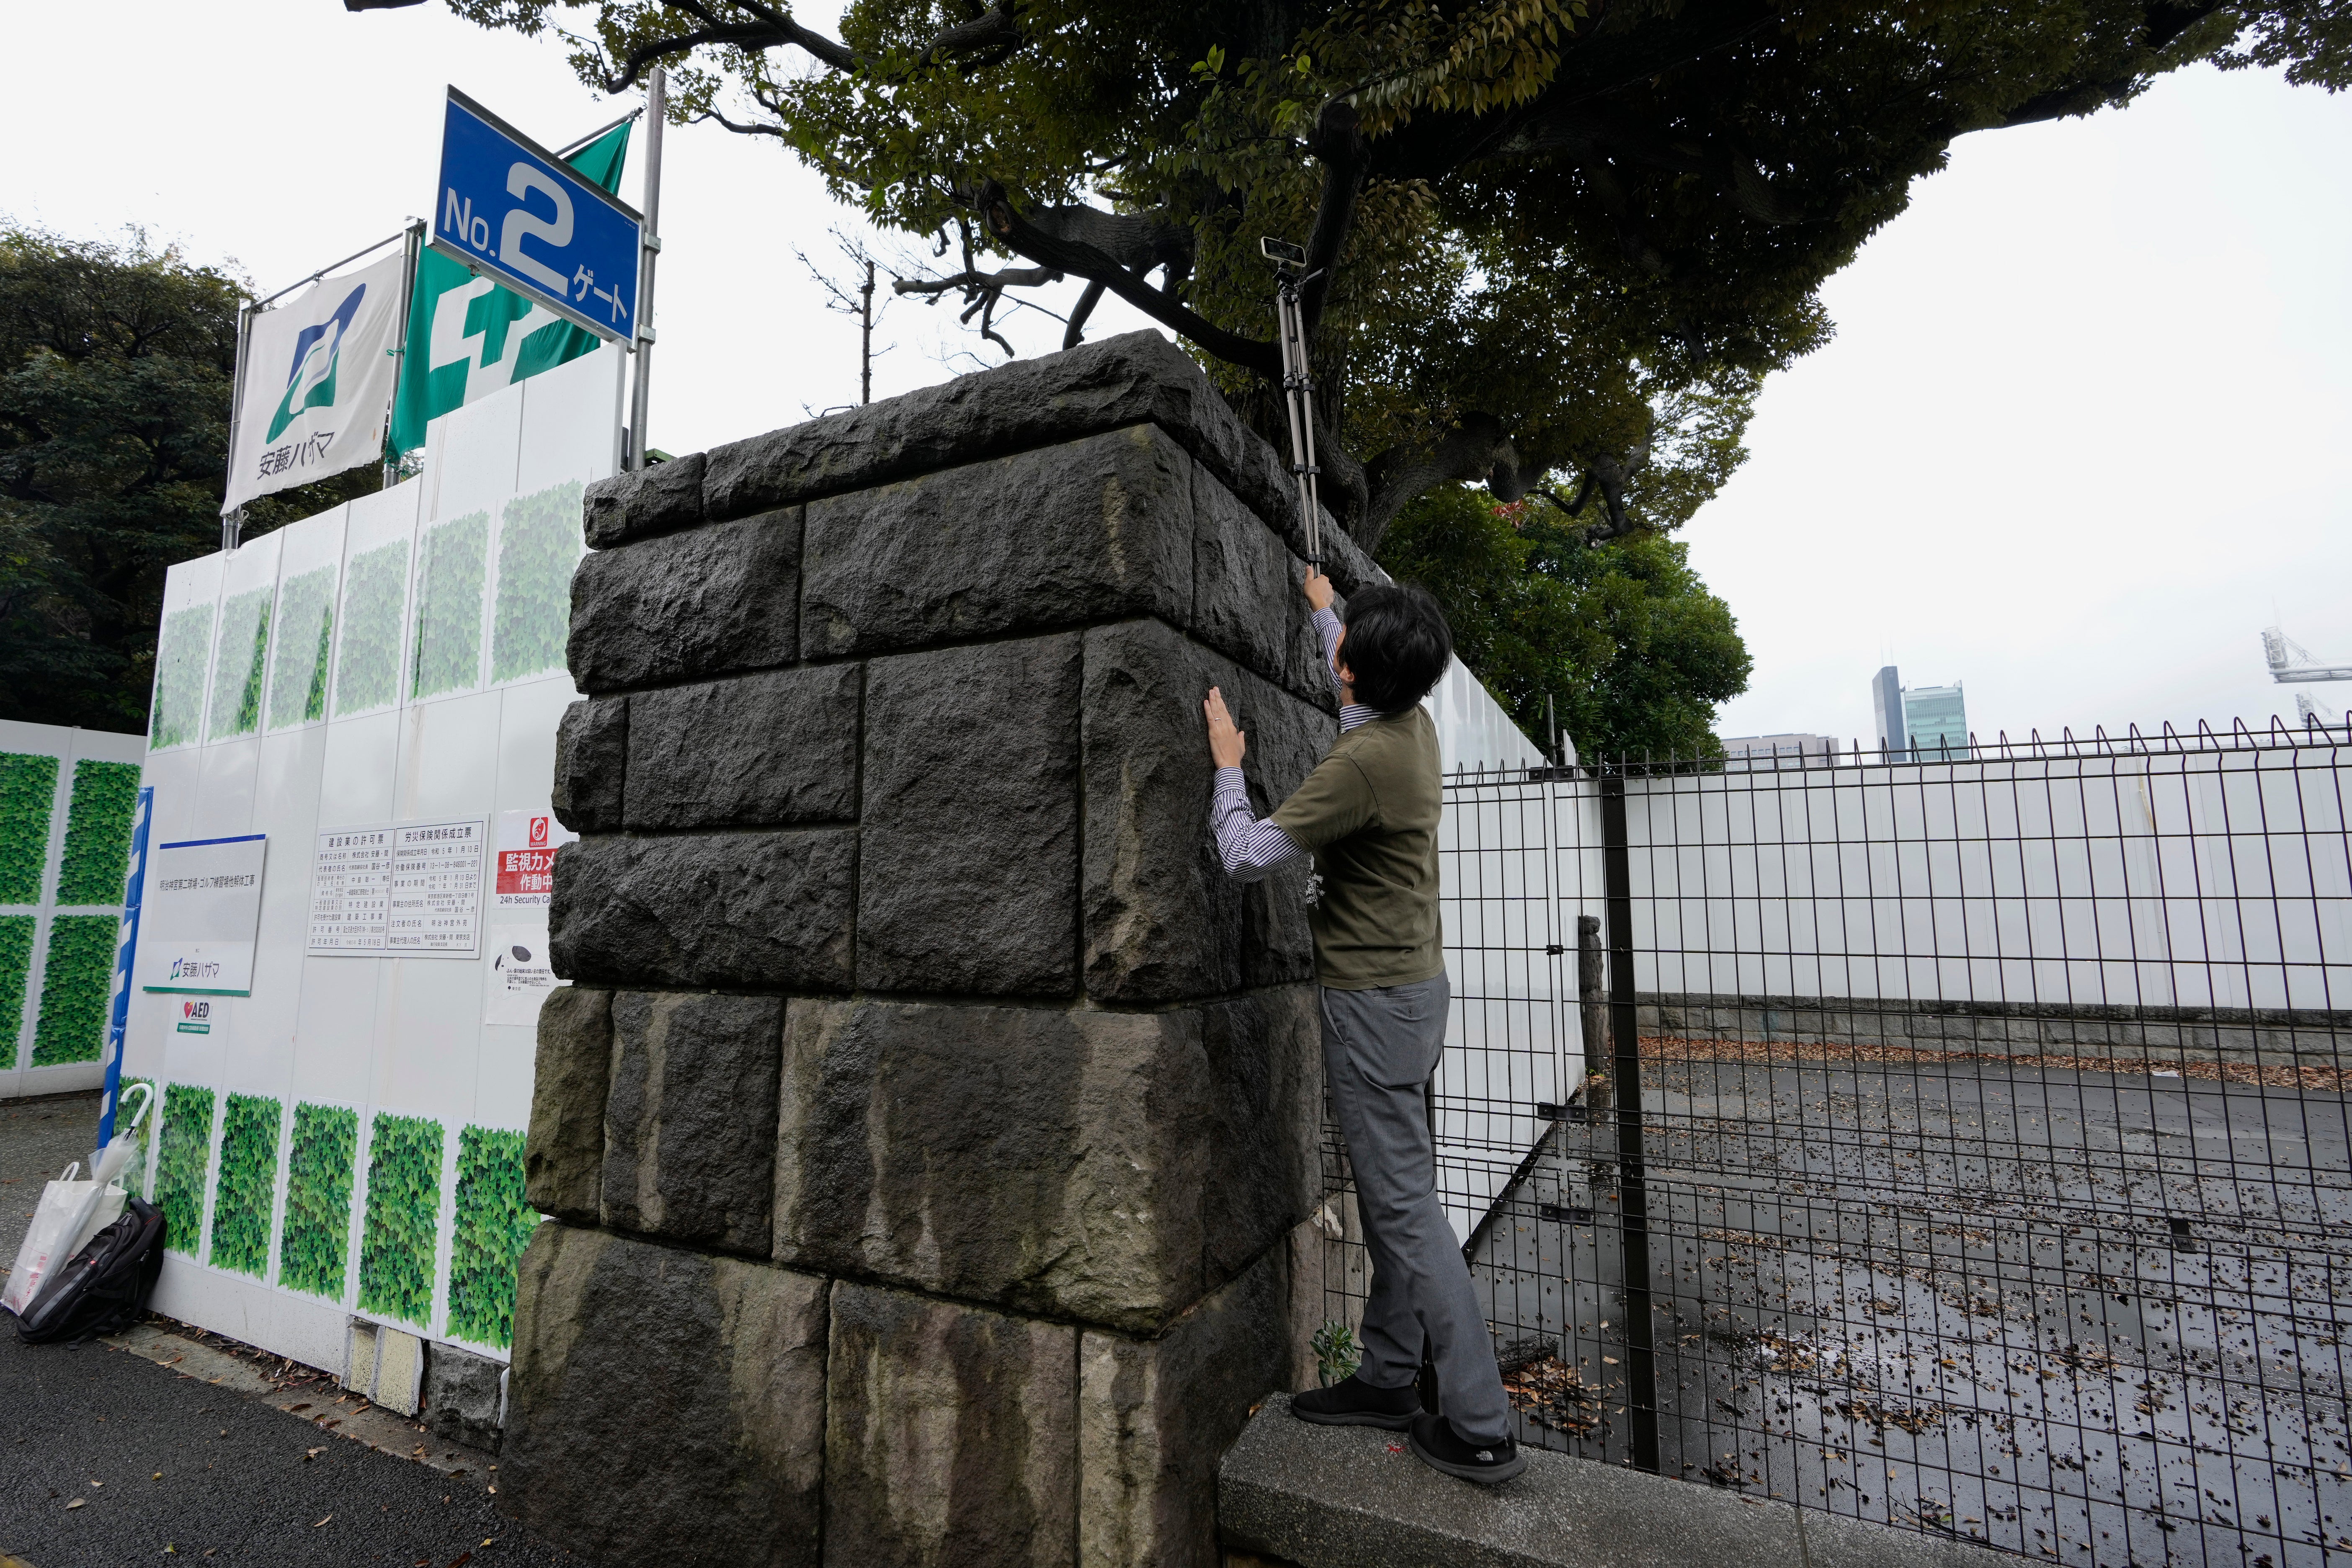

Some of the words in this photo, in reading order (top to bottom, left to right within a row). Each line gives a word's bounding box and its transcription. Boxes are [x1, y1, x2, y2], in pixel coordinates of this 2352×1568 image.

[573, 264, 627, 323] ゲート
[257, 431, 335, 480] 安藤ハザマ
[329, 834, 383, 847] 建設業の許可票
[405, 827, 472, 842] 労災保険関係成立票
[397, 848, 427, 857] 保険関係成立年月日
[395, 863, 426, 872] 労働保険番号
[430, 860, 477, 869] 13-1-08-846001-221
[500, 895, 512, 904] 24h
[514, 895, 540, 905] Security
[182, 961, 219, 978] 安藤ハザマ
[191, 1002, 209, 1018] AED
